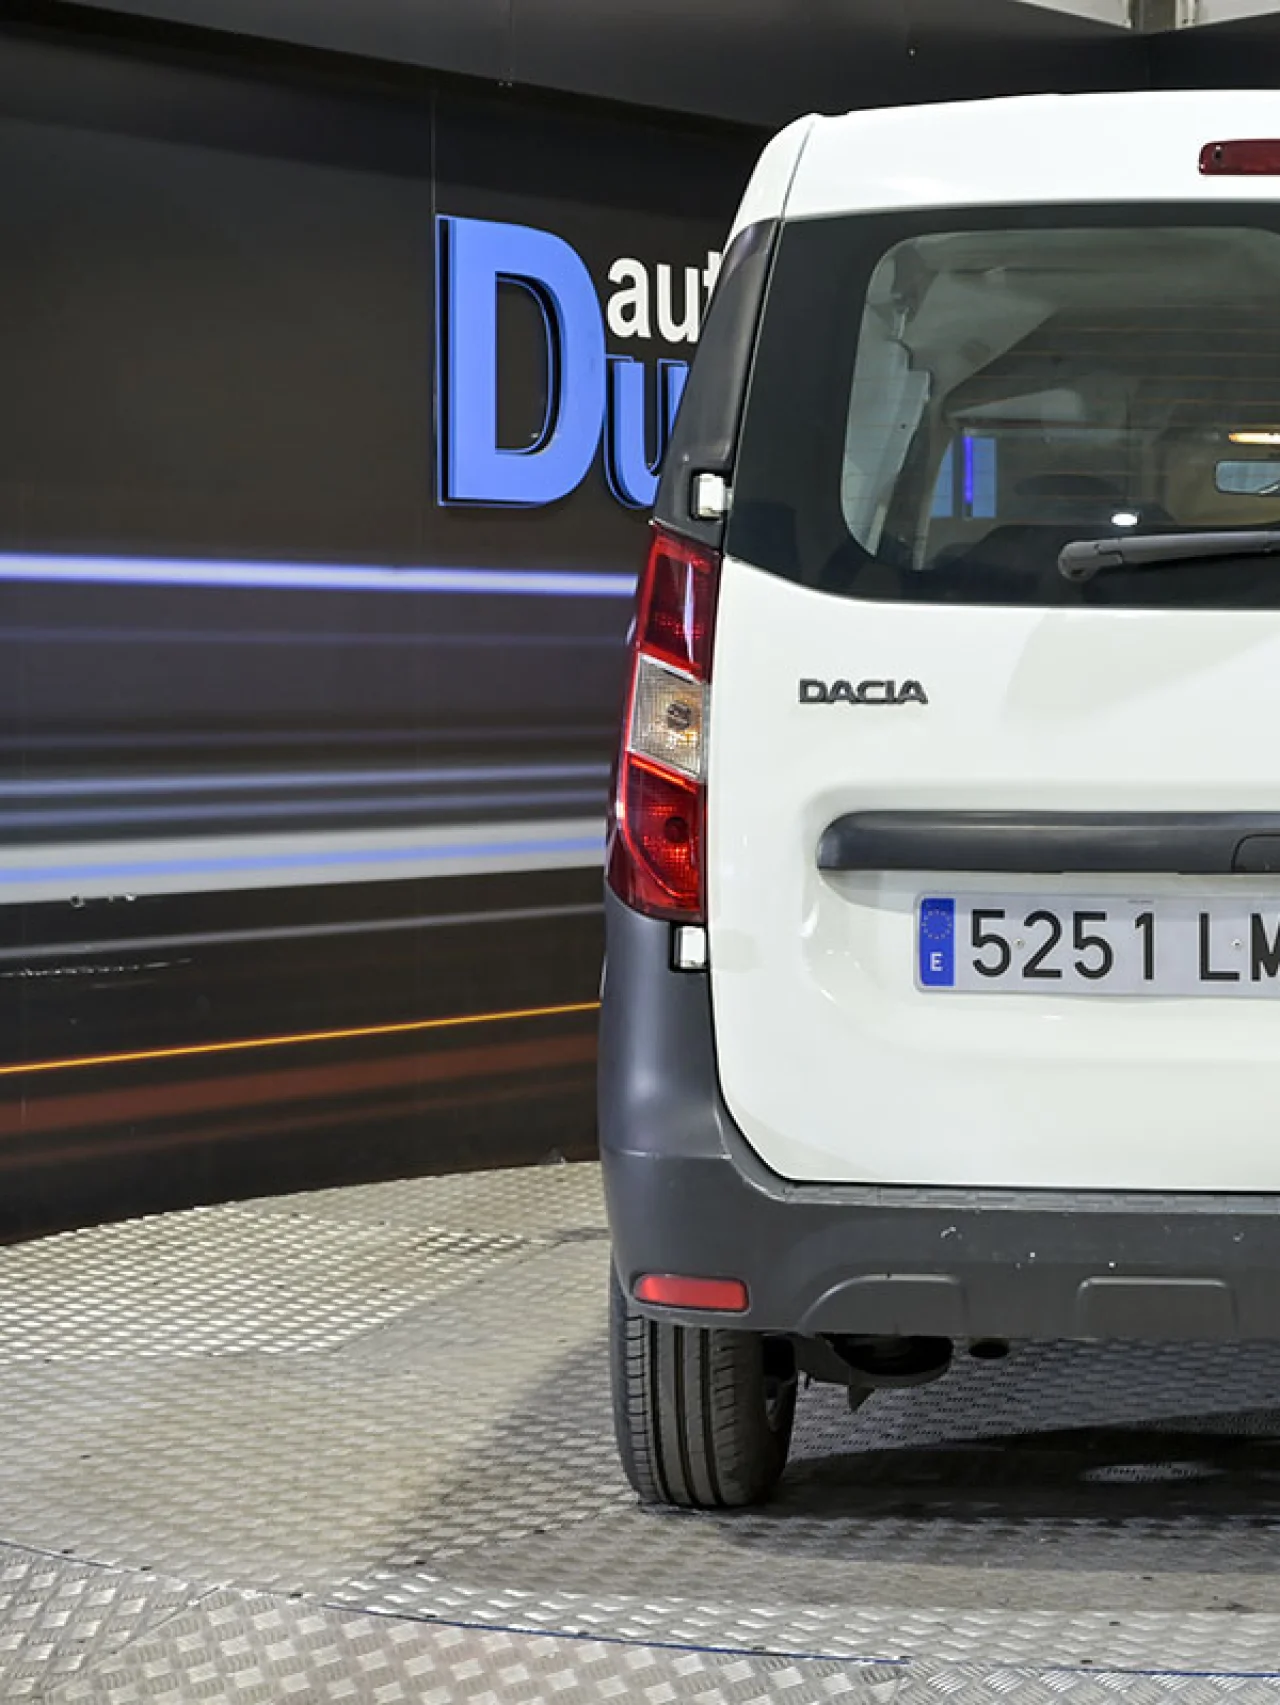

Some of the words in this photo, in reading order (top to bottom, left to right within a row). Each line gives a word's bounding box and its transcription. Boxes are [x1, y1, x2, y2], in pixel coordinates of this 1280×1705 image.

[799, 679, 928, 704] DACIA
[970, 908, 1155, 981] 5251
[928, 951, 943, 972] E
